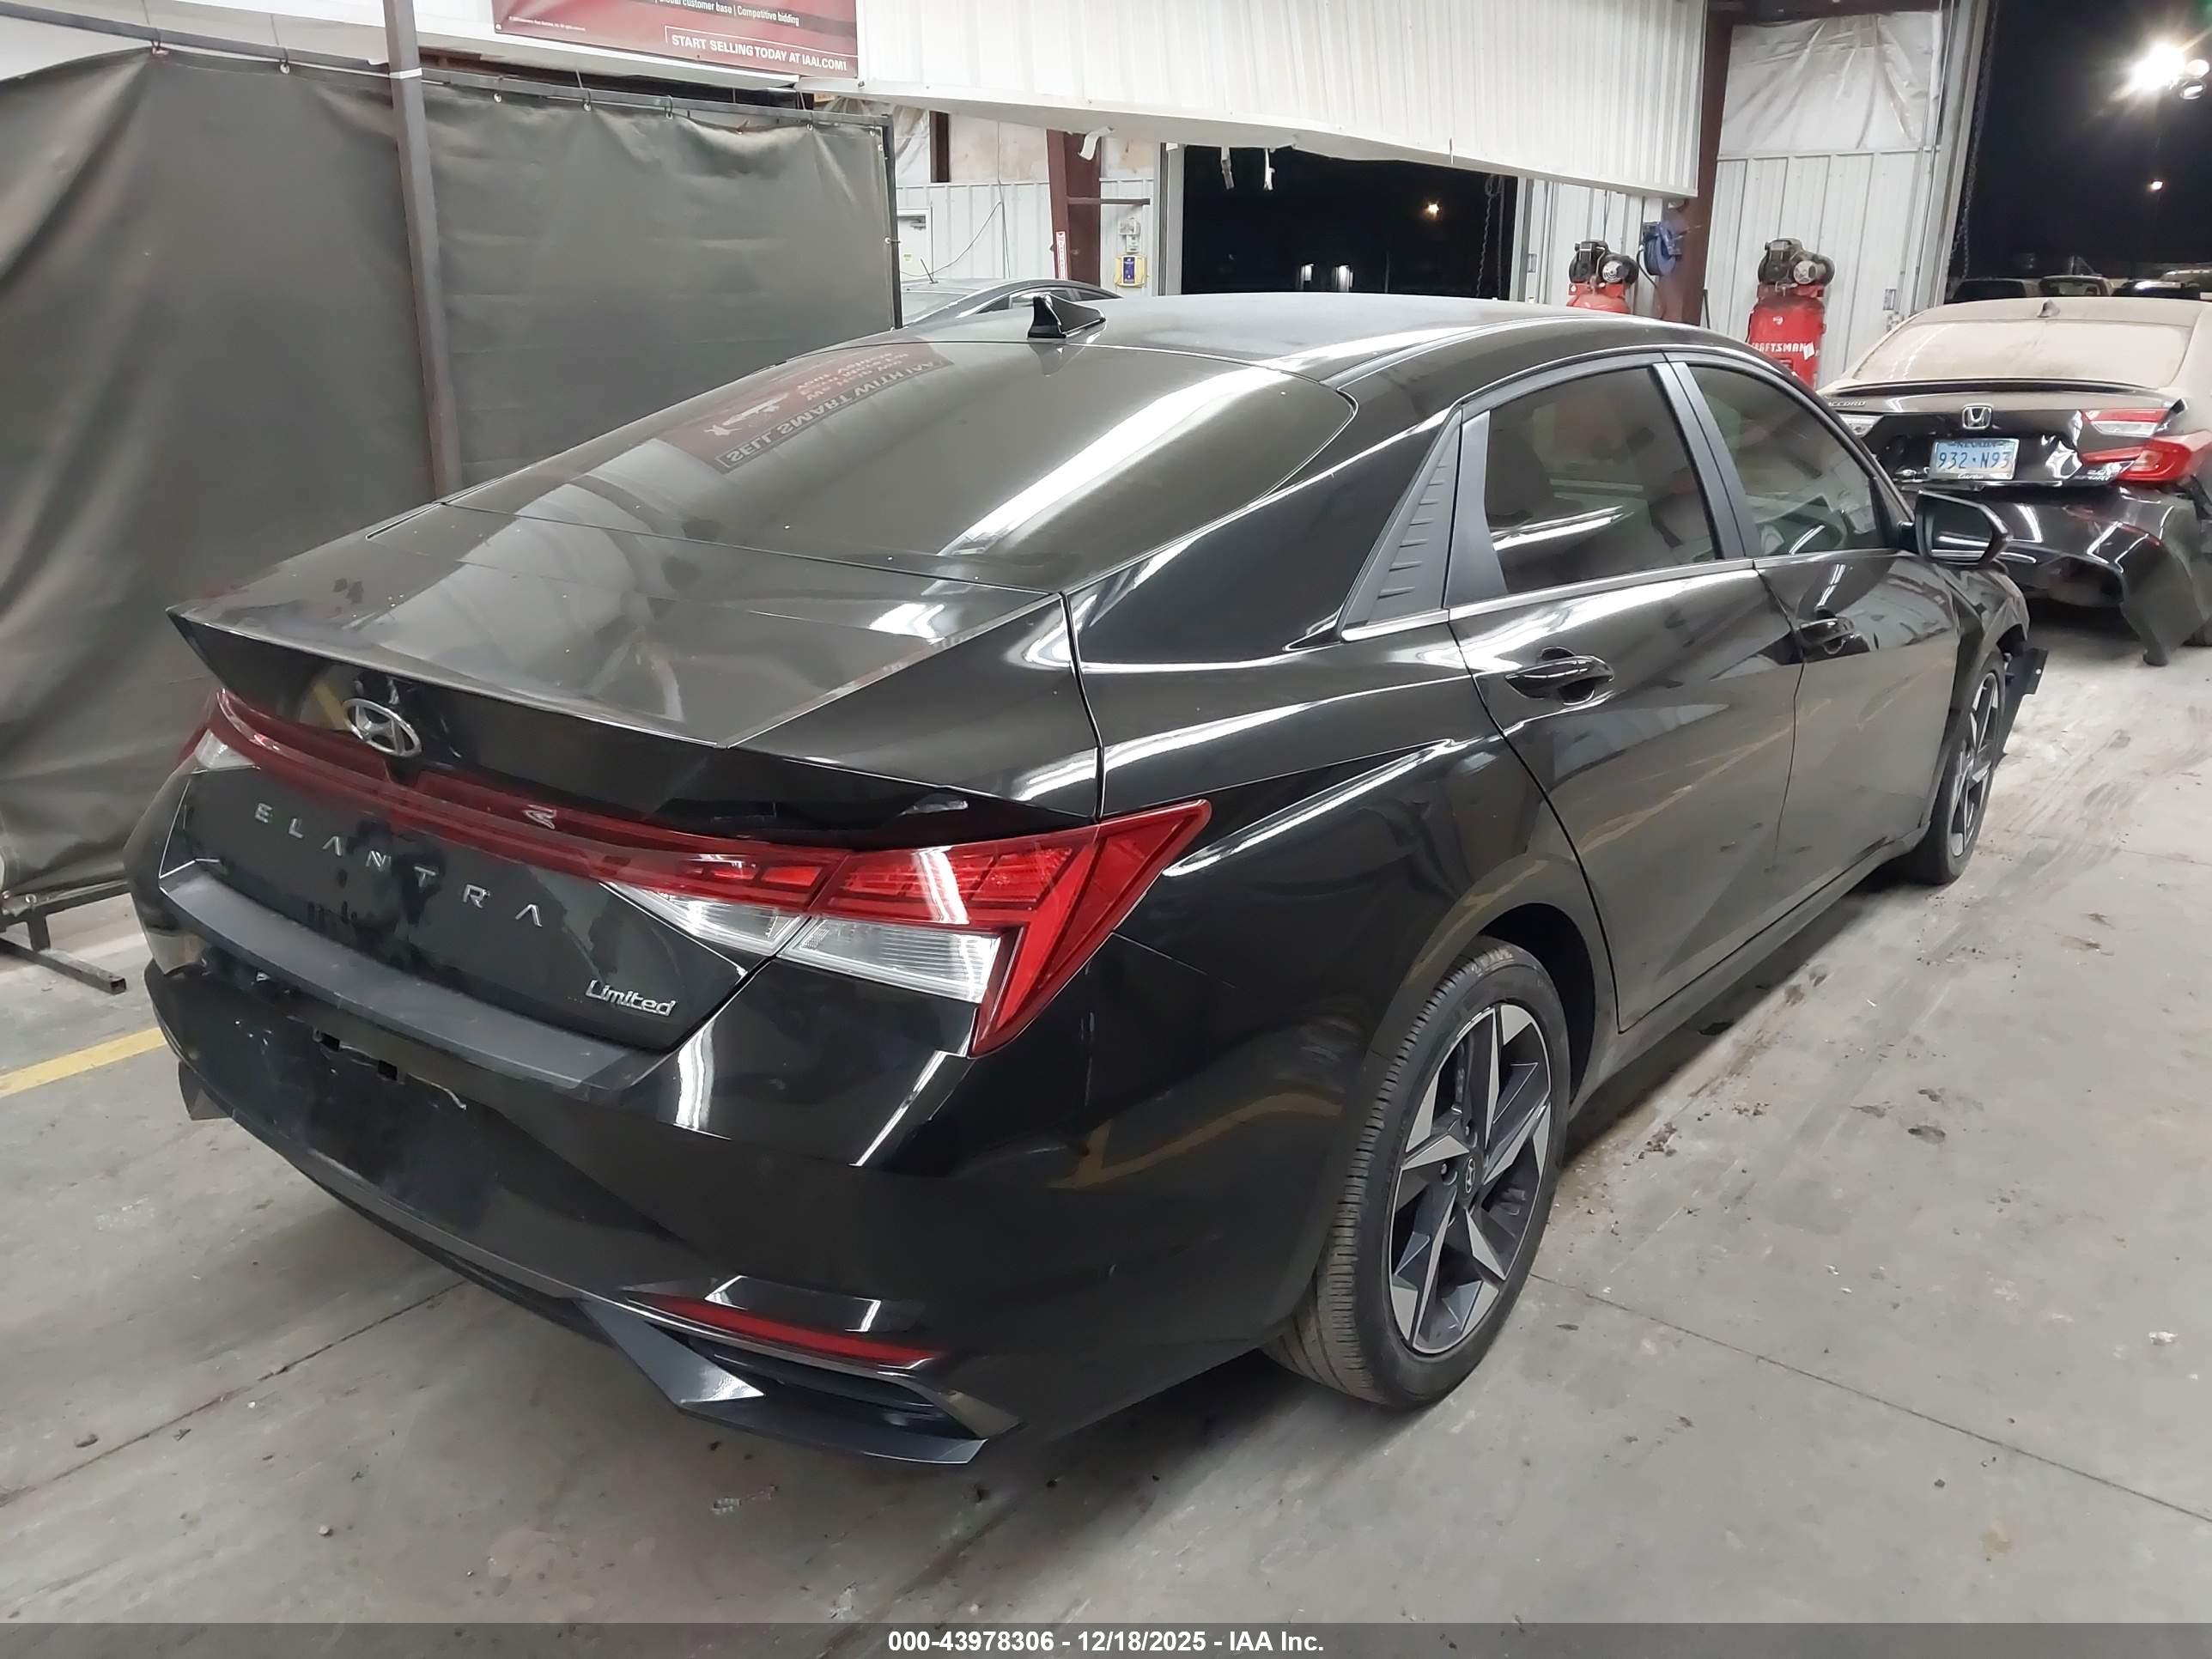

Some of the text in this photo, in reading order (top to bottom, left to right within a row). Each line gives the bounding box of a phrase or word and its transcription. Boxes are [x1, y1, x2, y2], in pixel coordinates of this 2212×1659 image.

[684, 0, 714, 11] customer
[716, 3, 732, 14] base
[777, 12, 799, 27] bidding
[672, 34, 707, 49] START
[709, 40, 754, 57] SELLING
[754, 46, 787, 61] TODAY
[789, 52, 801, 63] AT
[254, 803, 543, 927] ELANTRA
[586, 980, 676, 1017] Limited
